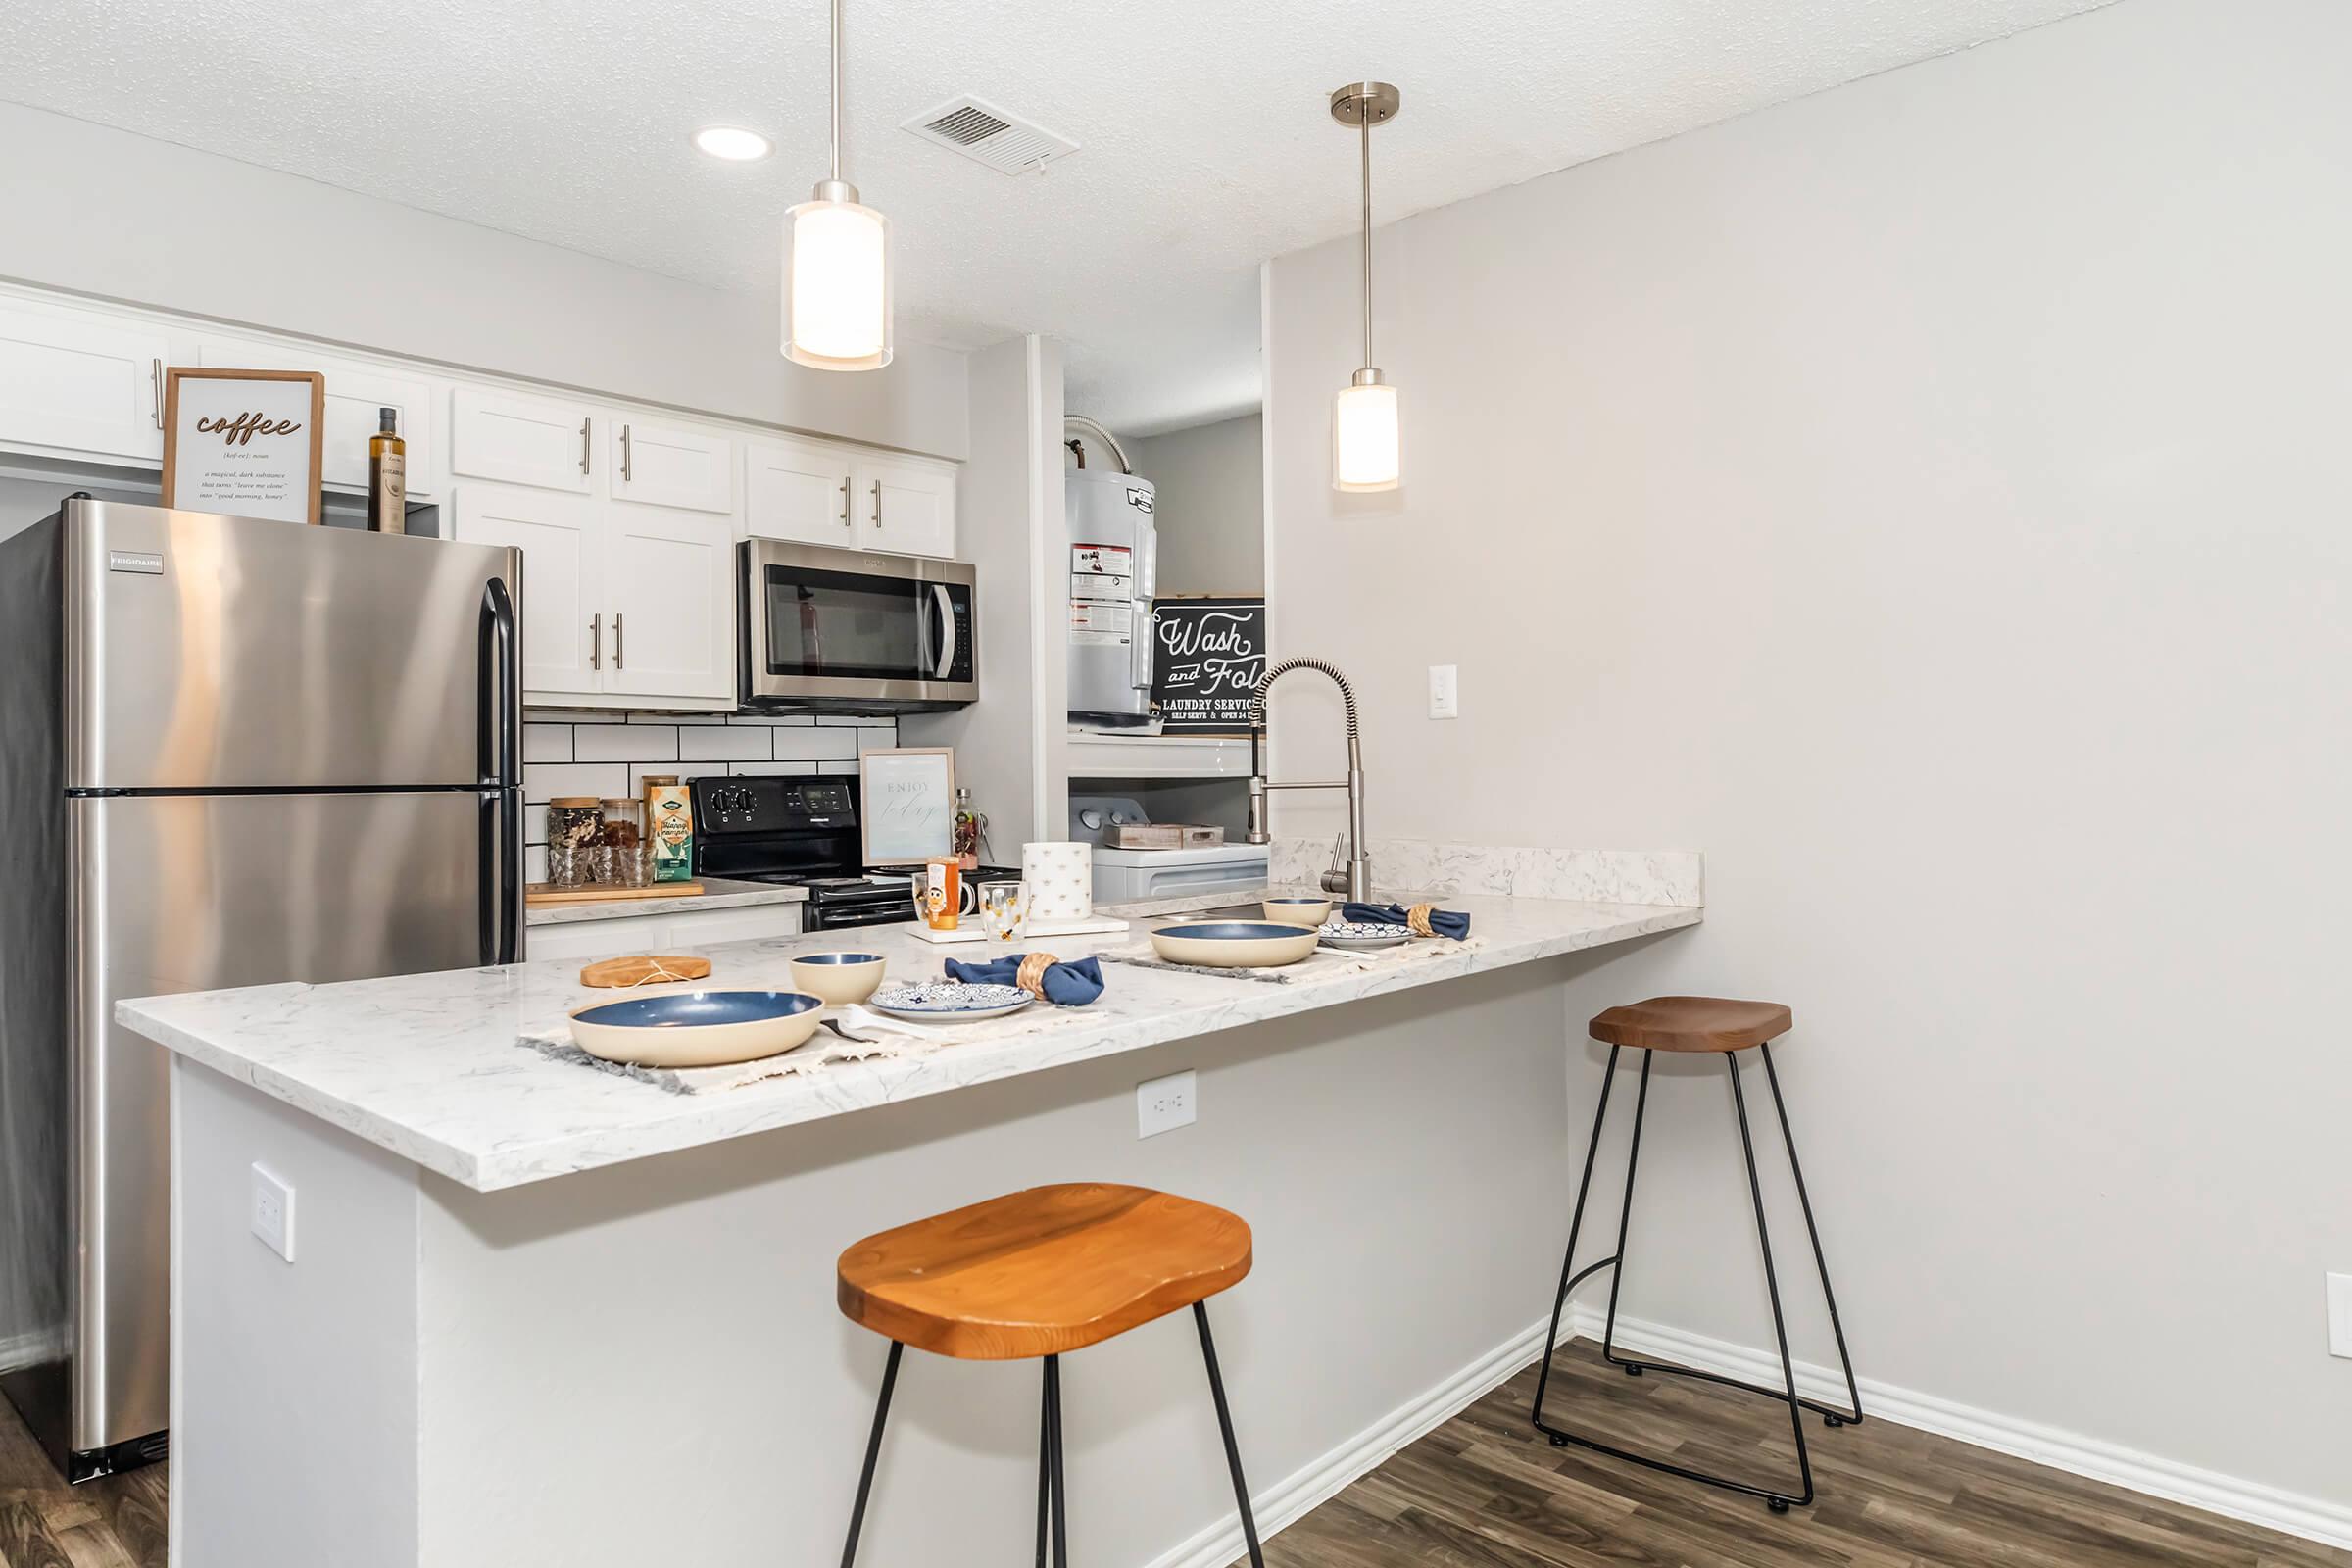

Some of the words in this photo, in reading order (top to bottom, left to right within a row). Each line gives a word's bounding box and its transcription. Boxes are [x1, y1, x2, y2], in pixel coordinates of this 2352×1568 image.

[196, 411, 302, 446] coffee
[1159, 612, 1254, 657] Wash
[1168, 663, 1201, 683] and
[1200, 654, 1266, 695] Fol
[1162, 699, 1212, 710] LAUNDRY
[887, 781, 929, 793] ENJOY
